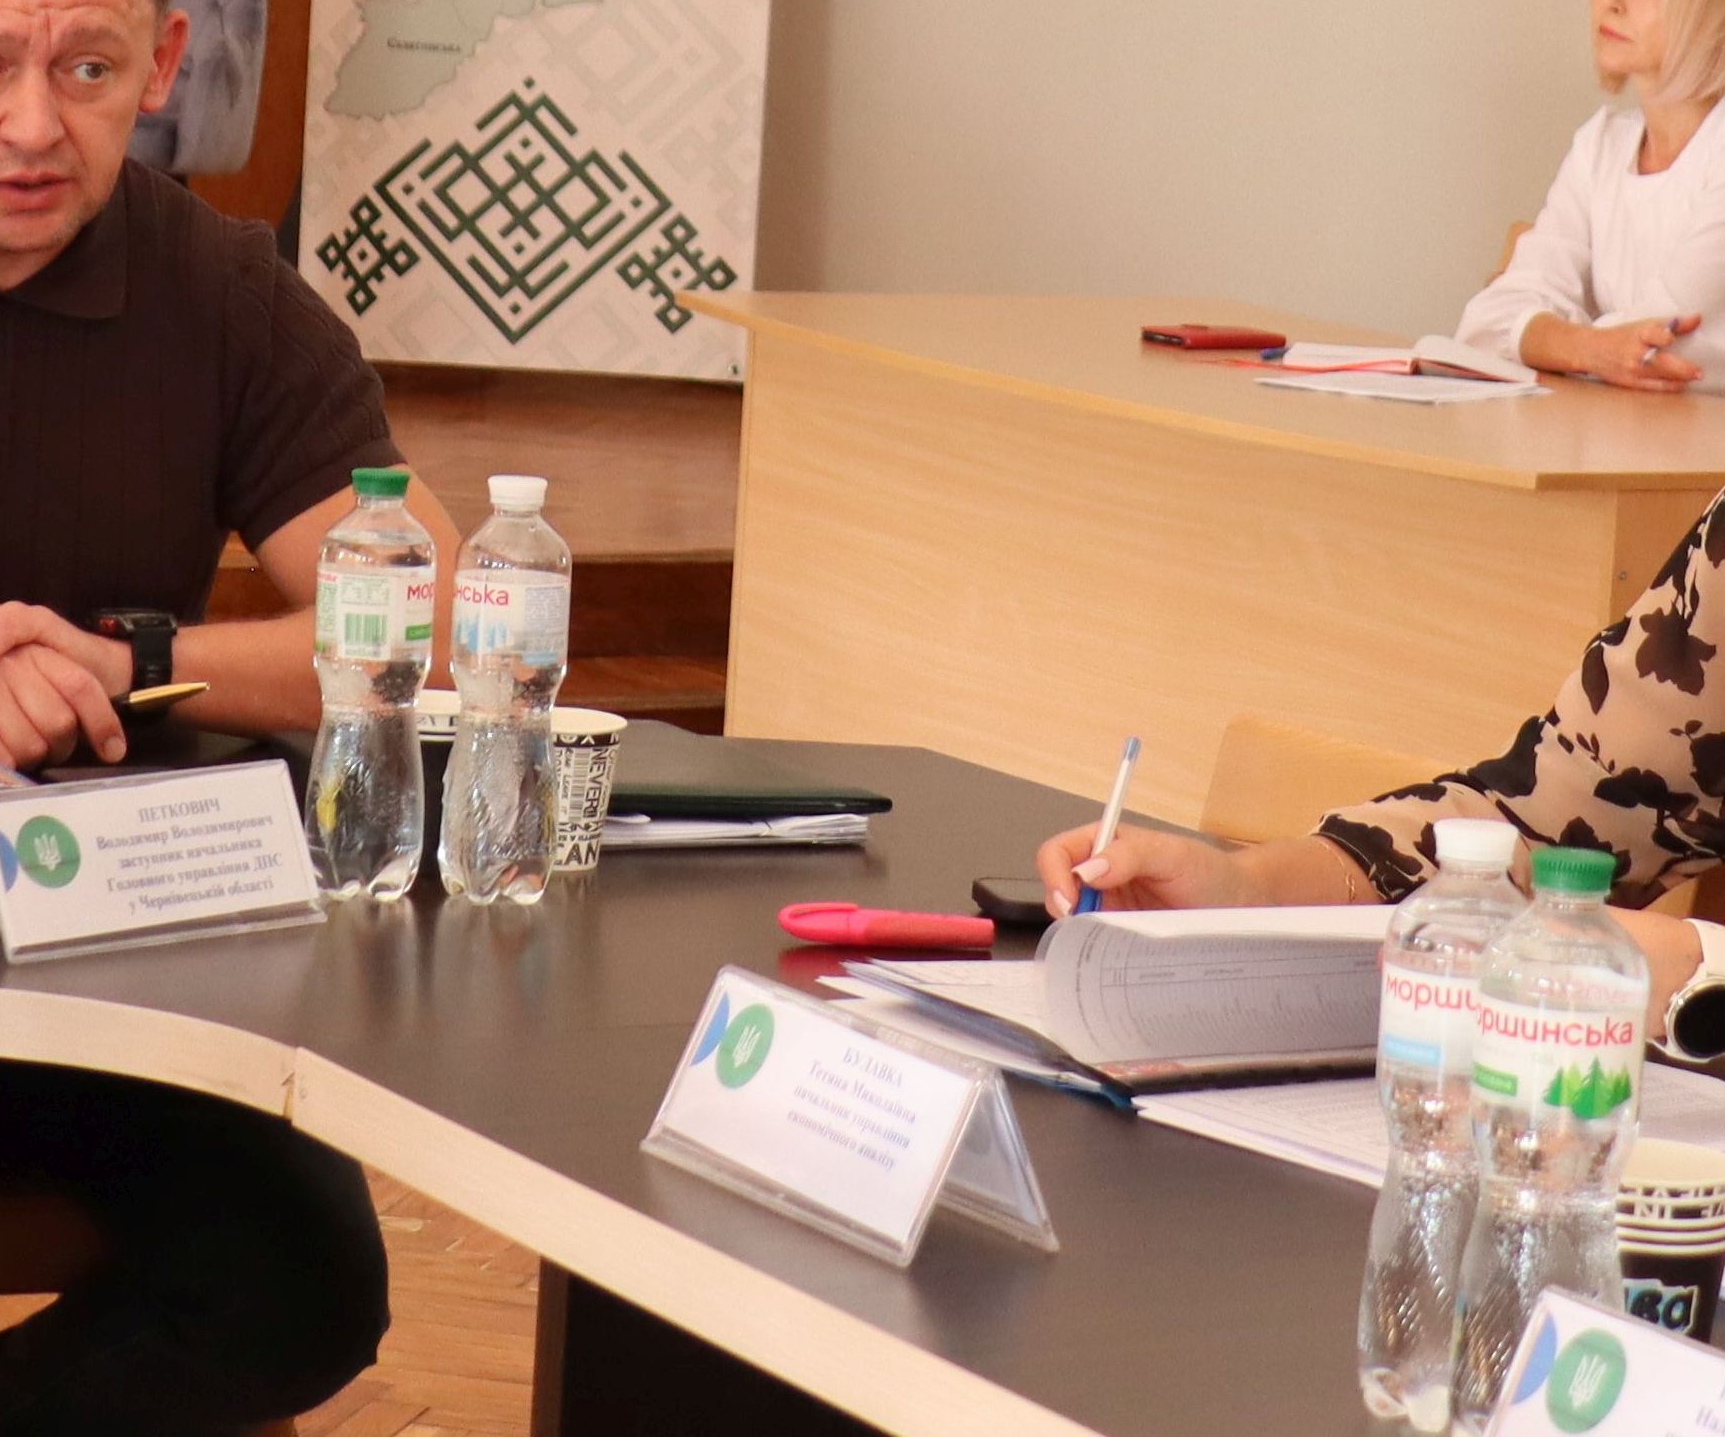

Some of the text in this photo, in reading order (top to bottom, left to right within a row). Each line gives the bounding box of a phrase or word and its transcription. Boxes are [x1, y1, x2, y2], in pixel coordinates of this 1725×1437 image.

[137, 797, 221, 824] ПЕТКОВИЧ
[95, 814, 275, 852] Володимир Володимирович
[186, 837, 264, 861] начальника
[106, 871, 175, 894] Головного
[227, 874, 275, 896] області
[808, 1059, 849, 1093] Тетяна
[842, 1046, 904, 1089] БУЛАВКА
